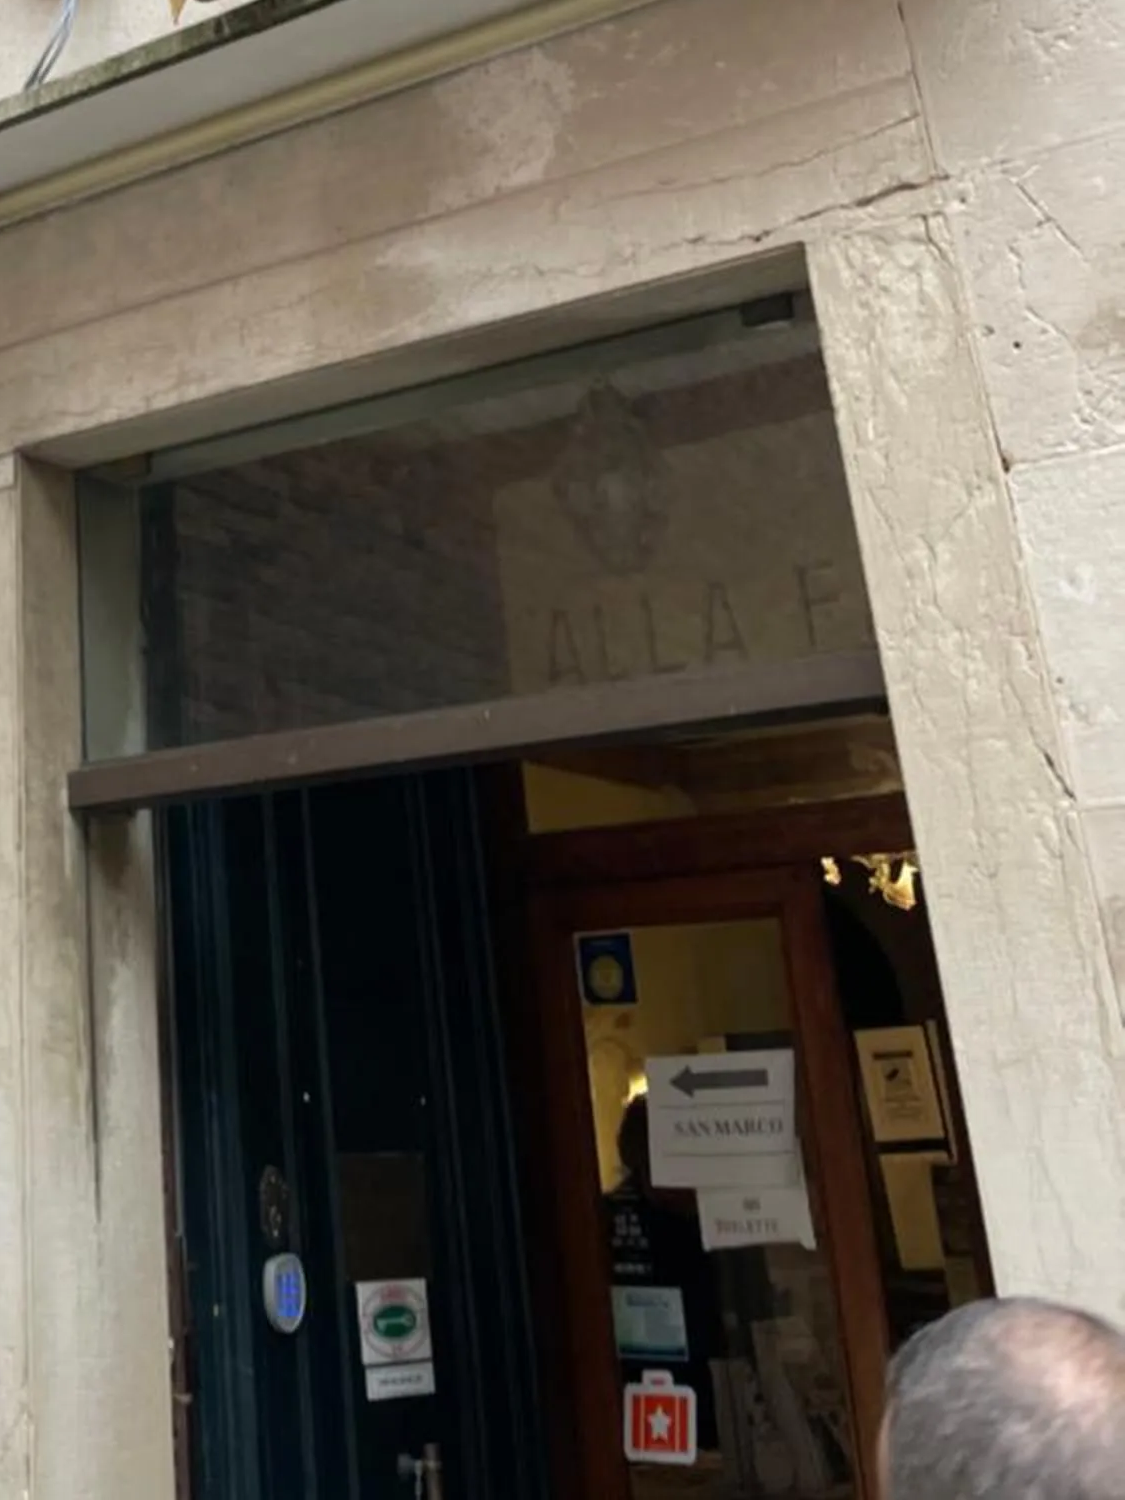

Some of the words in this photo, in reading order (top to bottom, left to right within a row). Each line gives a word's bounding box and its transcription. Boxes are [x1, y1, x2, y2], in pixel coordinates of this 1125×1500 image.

[548, 580, 750, 686] ALLA
[674, 1119, 711, 1138] SAN
[713, 1117, 784, 1137] MARCO
